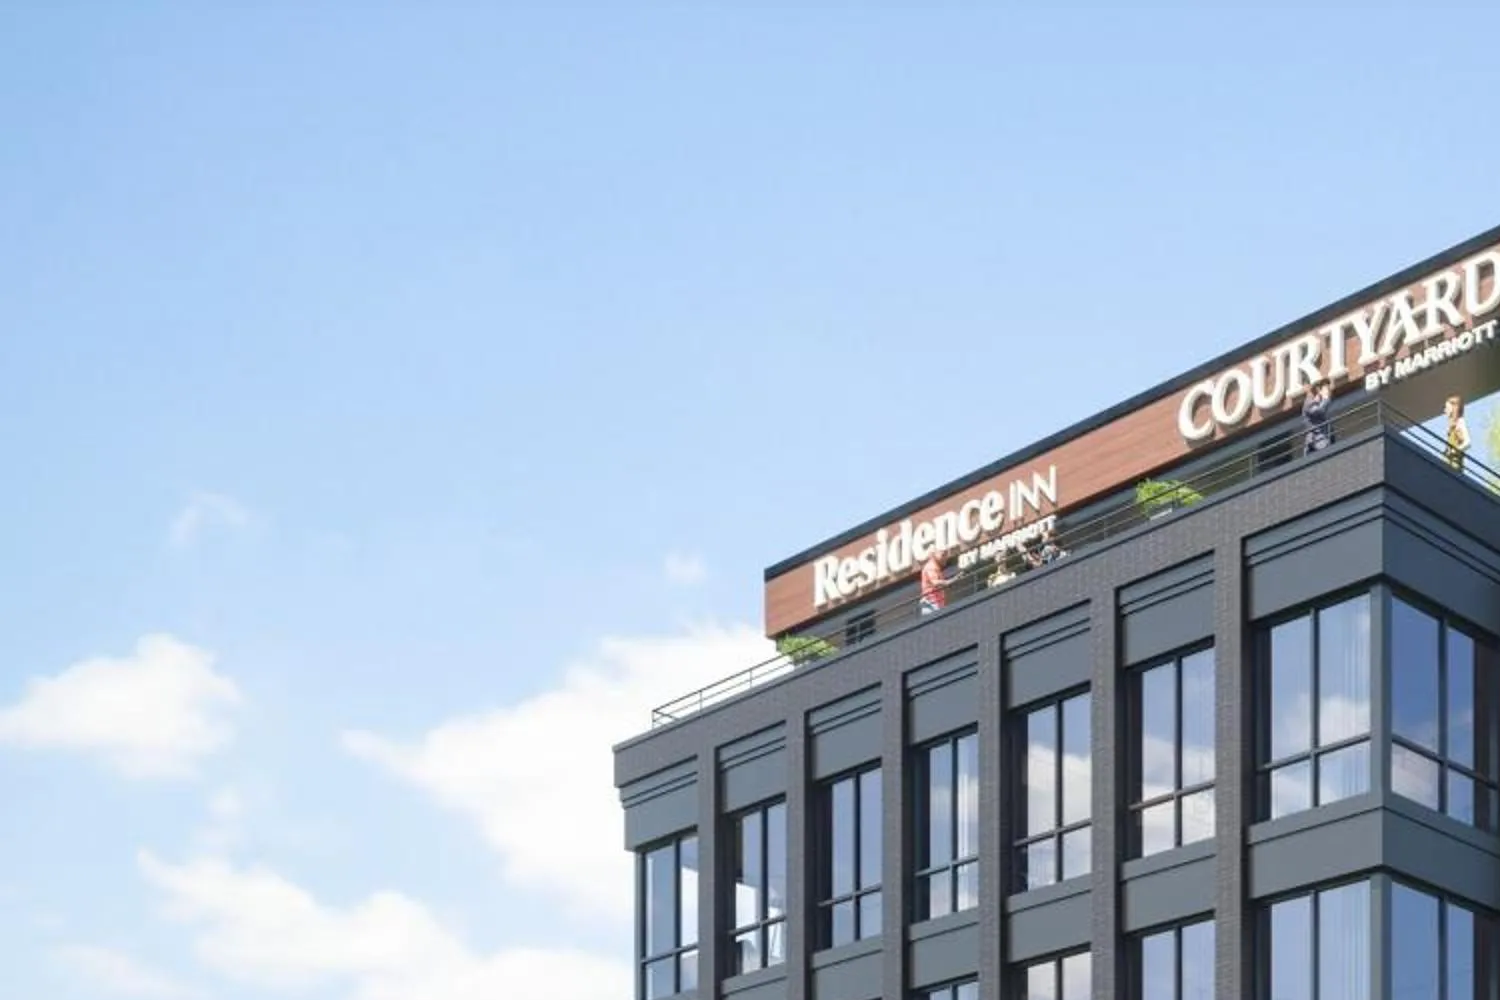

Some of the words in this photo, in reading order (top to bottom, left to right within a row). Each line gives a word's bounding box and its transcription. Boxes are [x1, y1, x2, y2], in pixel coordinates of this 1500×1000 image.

[1365, 366, 1392, 391] BY
[1394, 319, 1498, 379] MARRIOTT
[813, 490, 1005, 607] Residence
[1009, 465, 1057, 520] INN
[958, 547, 979, 569] BY
